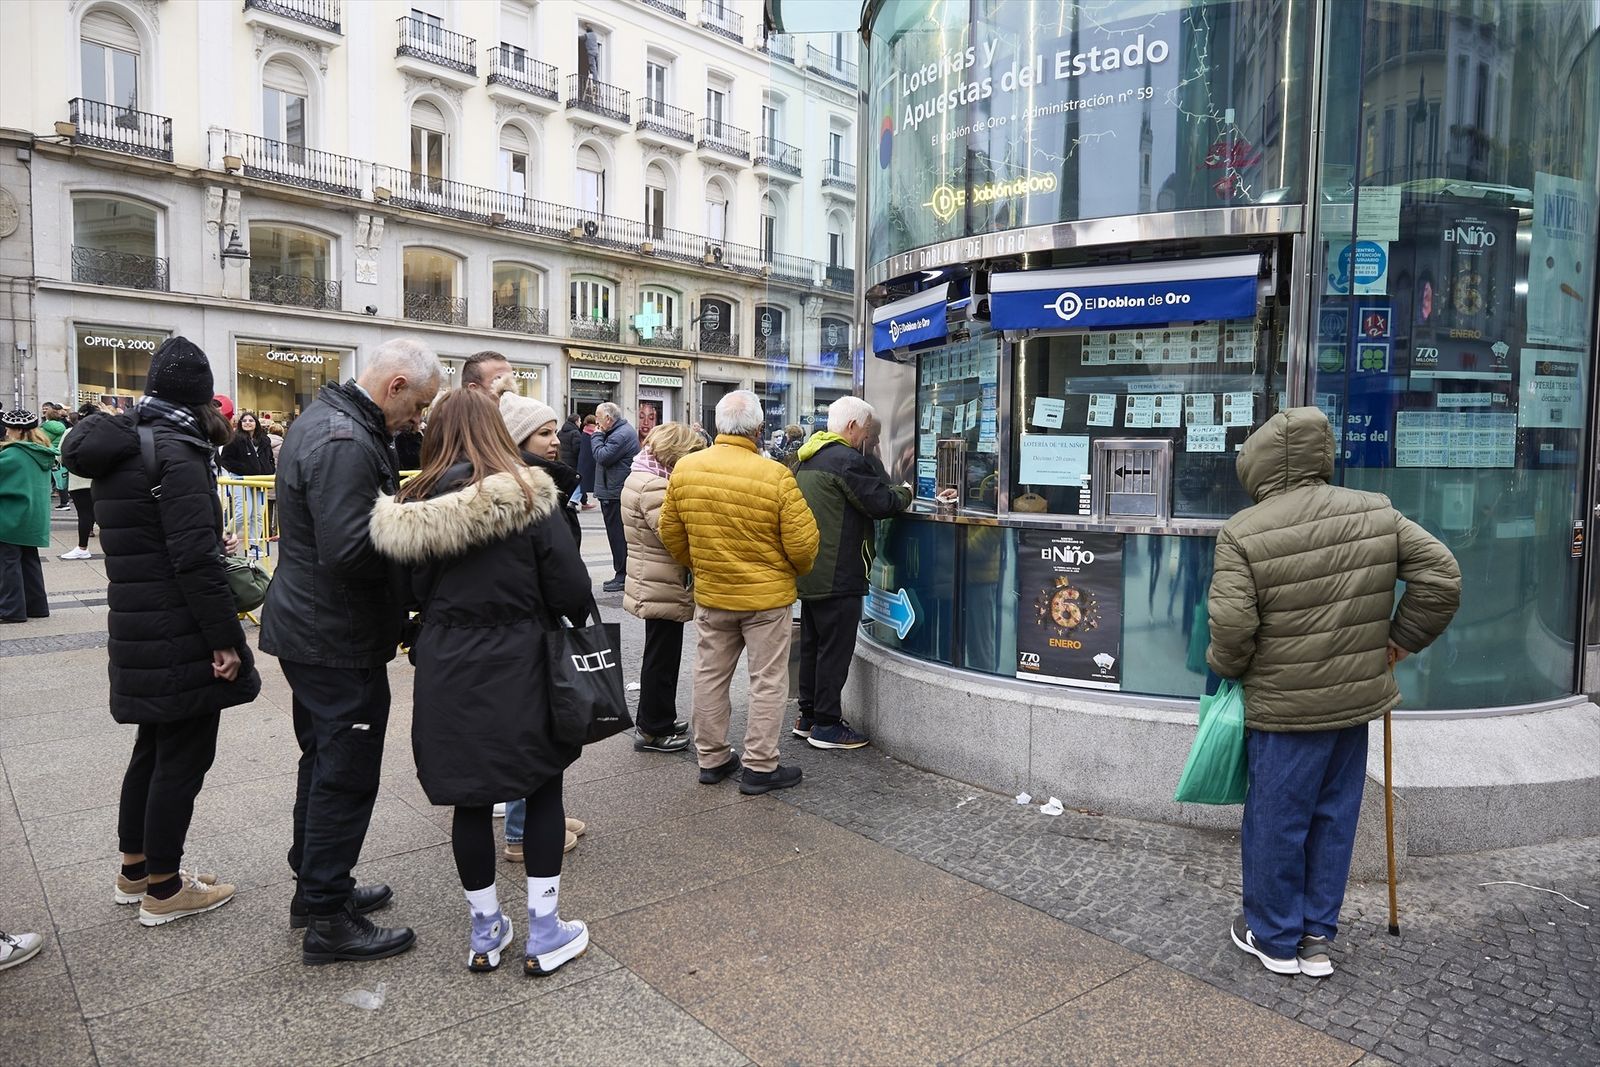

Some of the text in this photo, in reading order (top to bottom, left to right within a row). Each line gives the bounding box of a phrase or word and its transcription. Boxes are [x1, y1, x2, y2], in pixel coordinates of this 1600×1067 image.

[983, 38, 998, 69] y
[903, 34, 1169, 131] Apuestas del Estado
[973, 121, 985, 133] de
[987, 116, 1007, 128] Oro
[1022, 93, 1114, 121] Administración
[1137, 86, 1154, 100] 59
[1029, 176, 1054, 192] Oro
[1456, 225, 1496, 248] Niño
[904, 255, 913, 271] EL
[967, 241, 981, 258] DE
[997, 234, 1025, 253] ORO
[1063, 292, 1191, 312] D El Doblon de Oro
[1450, 328, 1482, 340] ENERO
[127, 339, 155, 350] 2000
[1416, 347, 1439, 358] 770
[301, 354, 324, 364] 2000
[581, 351, 681, 367] FARMACIA COMPANY
[572, 369, 619, 381] FARMACIA
[640, 376, 681, 385] COMPANY
[1364, 415, 1372, 427] y
[1370, 430, 1388, 442] del
[1041, 545, 1095, 566] El Niño
[1049, 638, 1082, 650] ENERO
[1020, 651, 1040, 663] 770
